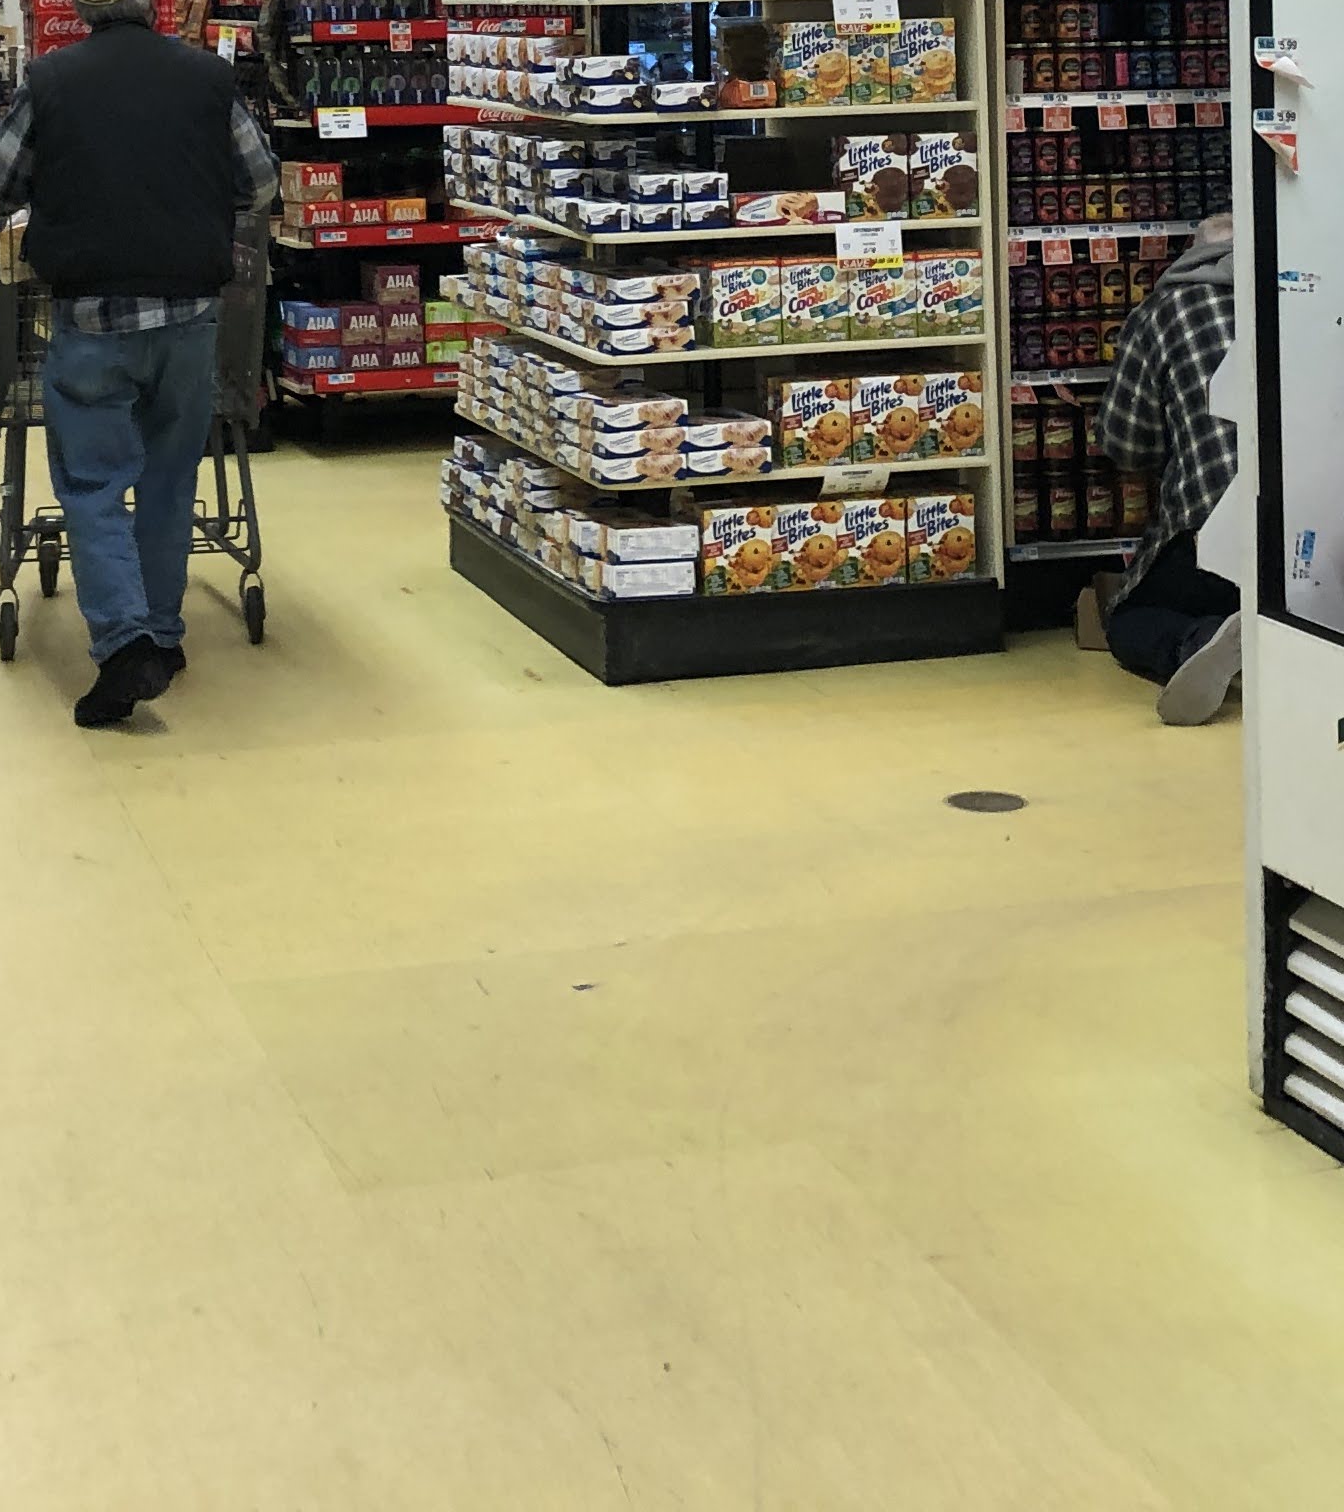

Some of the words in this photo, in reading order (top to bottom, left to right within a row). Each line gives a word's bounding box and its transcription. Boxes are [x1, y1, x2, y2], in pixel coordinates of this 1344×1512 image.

[791, 26, 823, 50] Little
[841, 24, 867, 33] SAVE
[898, 25, 929, 49] Little
[802, 40, 834, 61] Bites
[908, 37, 940, 59] Bites
[848, 140, 880, 167] Little
[919, 138, 951, 164] Little
[930, 151, 962, 173] Bites
[859, 154, 892, 176] Bites
[309, 171, 338, 186] AHA
[311, 209, 340, 225] AHA
[353, 208, 381, 223] AHA
[394, 208, 421, 221] AHA
[842, 260, 870, 268] SAVE
[924, 261, 947, 280] Little
[386, 274, 415, 288] AHA
[720, 270, 744, 288] Little
[728, 279, 752, 294] Bites
[789, 267, 812, 286] Little
[796, 276, 820, 291] Bites
[931, 270, 955, 286] Bites
[306, 316, 336, 331] AHA
[349, 315, 378, 329] AHA
[390, 313, 419, 328] AHA
[307, 355, 336, 369] AHA
[351, 353, 380, 368] AHA
[391, 352, 420, 366] AHA
[791, 388, 824, 413] Little
[860, 382, 892, 408] Little
[925, 377, 956, 404] Little
[935, 390, 968, 413] Bites
[802, 400, 835, 422] Bites
[871, 395, 904, 417] Bites
[777, 509, 809, 535] Little
[844, 505, 877, 532] Little
[916, 501, 948, 528] Little
[712, 513, 745, 539] Little
[788, 522, 821, 545] Bites
[856, 518, 889, 541] Bites
[926, 515, 960, 538] Bites
[723, 527, 756, 550] Bites
